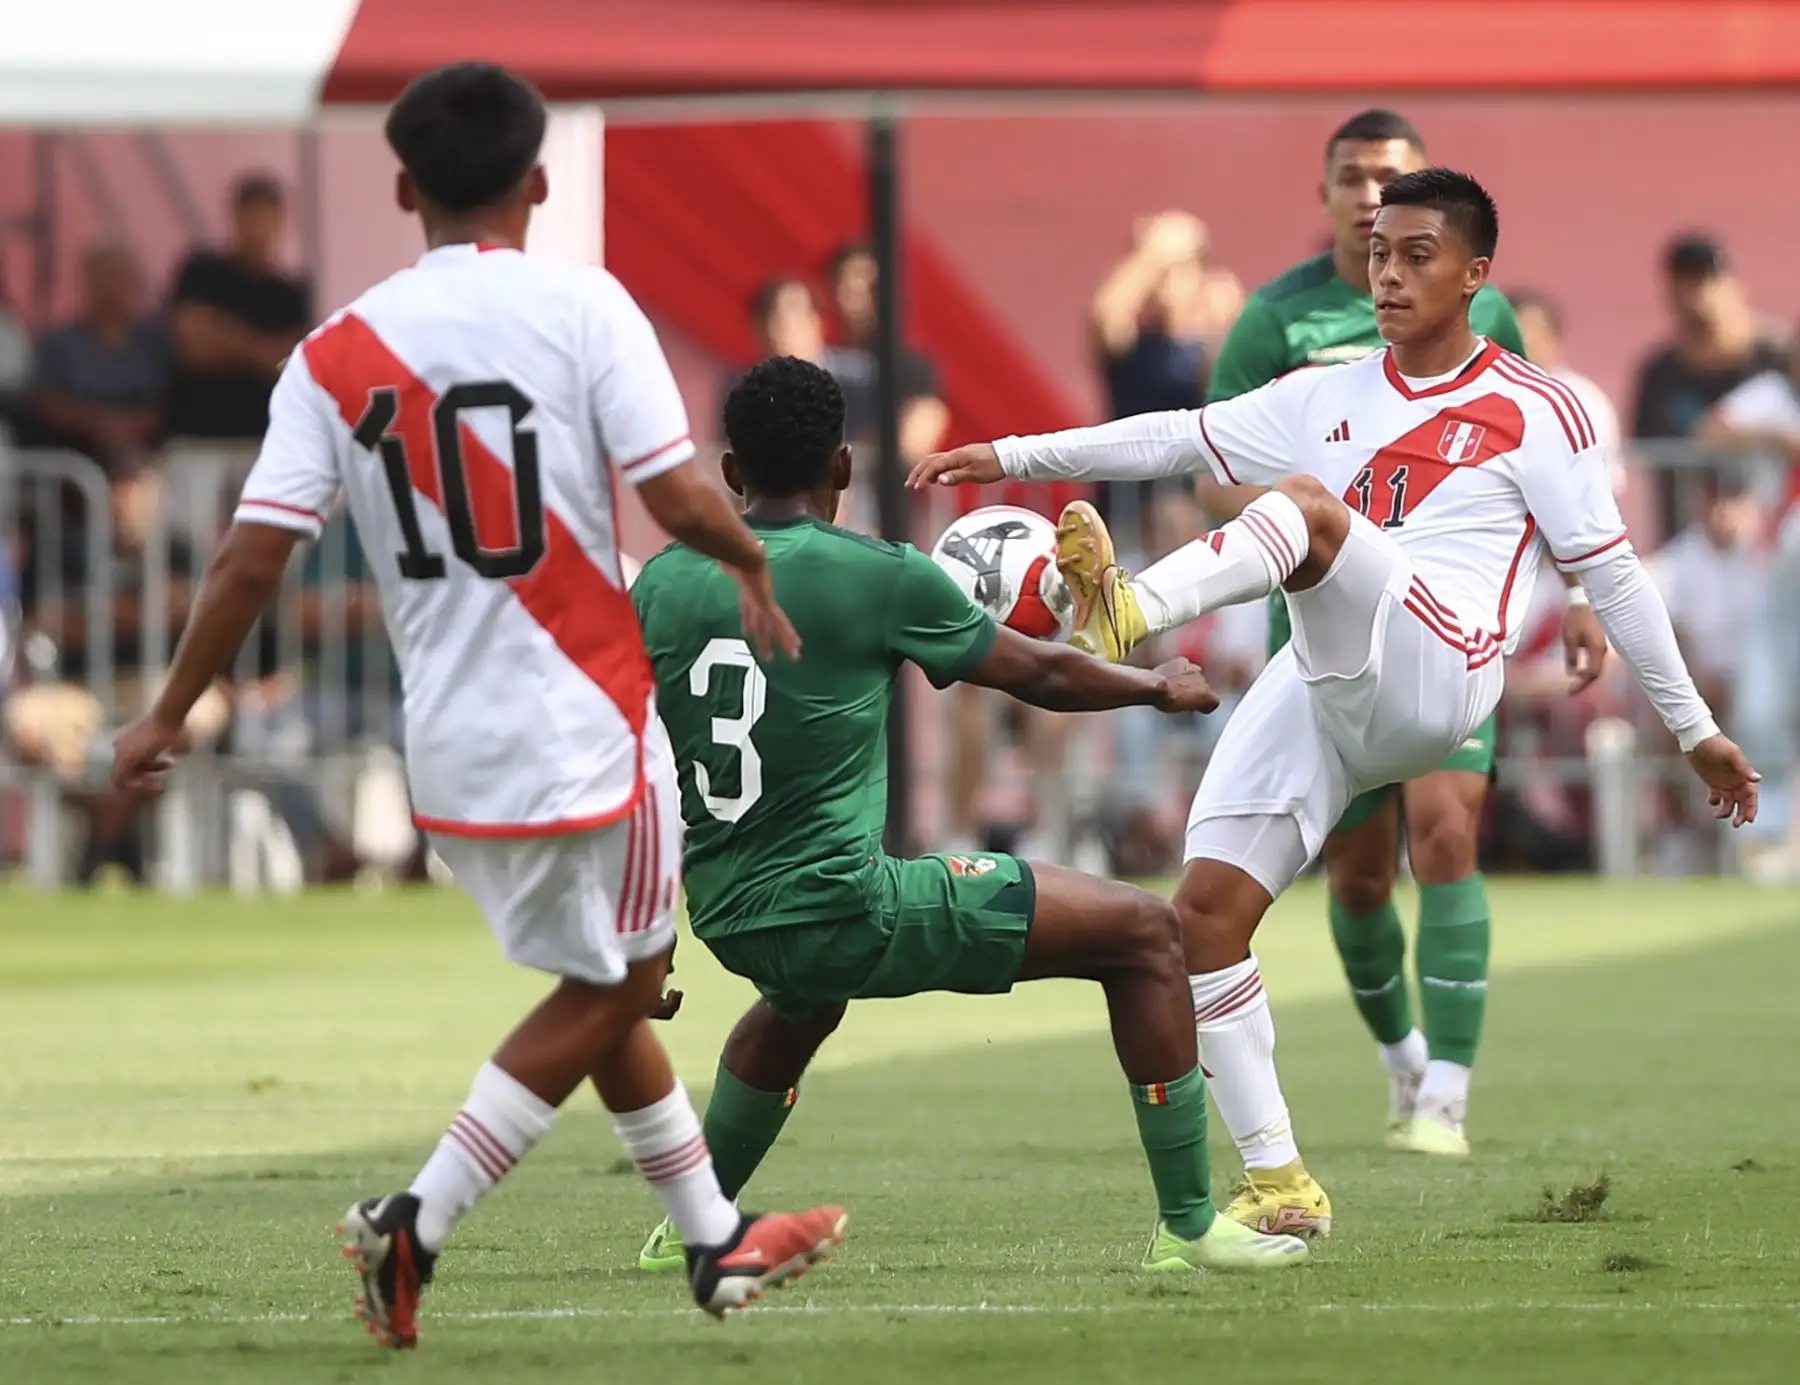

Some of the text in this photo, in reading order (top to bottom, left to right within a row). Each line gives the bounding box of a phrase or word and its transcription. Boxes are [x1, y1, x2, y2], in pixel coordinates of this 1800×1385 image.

[352, 379, 546, 579] 10
[1353, 465, 1408, 530] 11
[689, 637, 767, 824] 3
